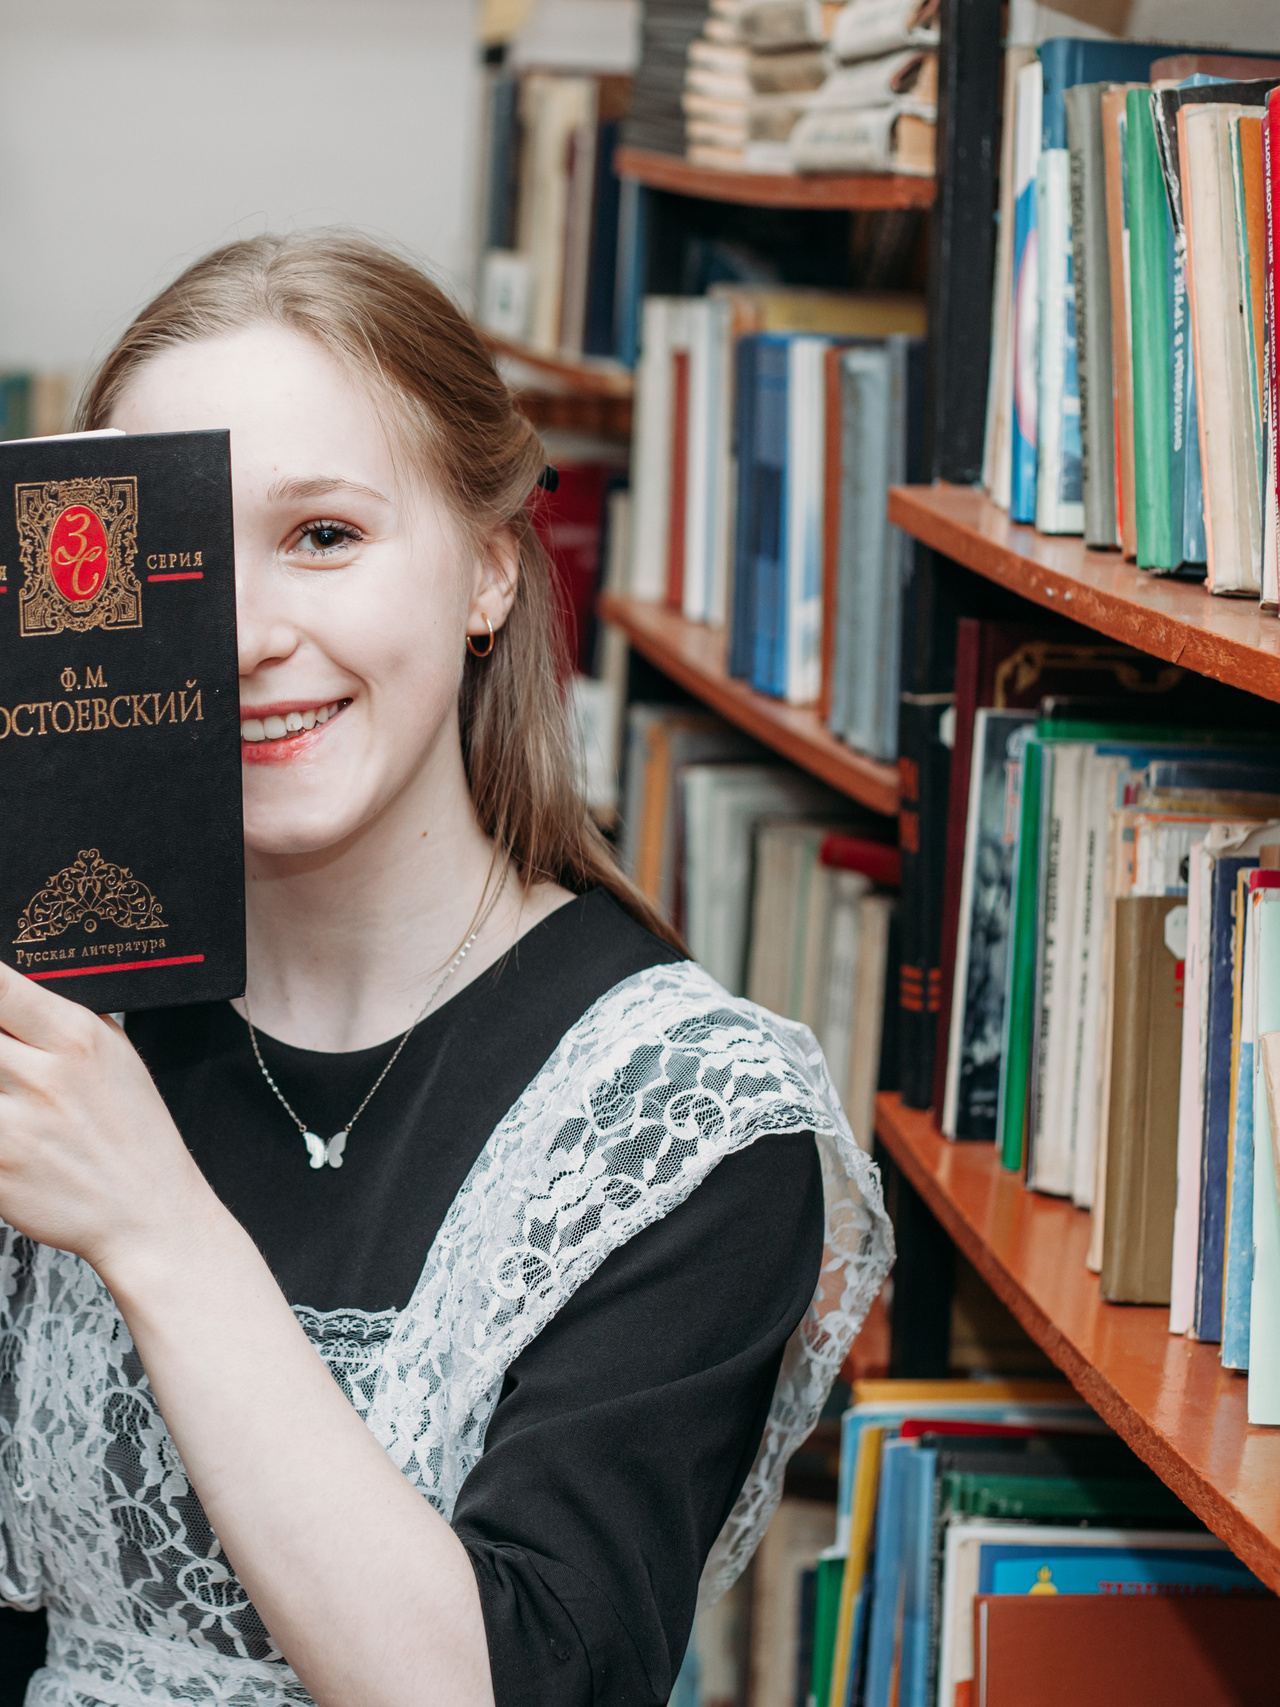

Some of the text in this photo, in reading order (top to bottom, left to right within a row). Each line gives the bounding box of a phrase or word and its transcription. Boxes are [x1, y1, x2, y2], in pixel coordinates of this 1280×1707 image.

[1070, 150, 1084, 234] ПОБЕДА
[1263, 127, 1273, 265] МЕТАЛЛООБРАБОТКА
[1173, 274, 1185, 331] ТРУДЕ
[1173, 332, 1184, 347] В
[1173, 349, 1185, 452] ОНОХОЙЦЫ
[1262, 341, 1270, 423] МУЗЫКА
[146, 551, 203, 570] СЕРИЯ
[16, 938, 167, 968] Русская литература
